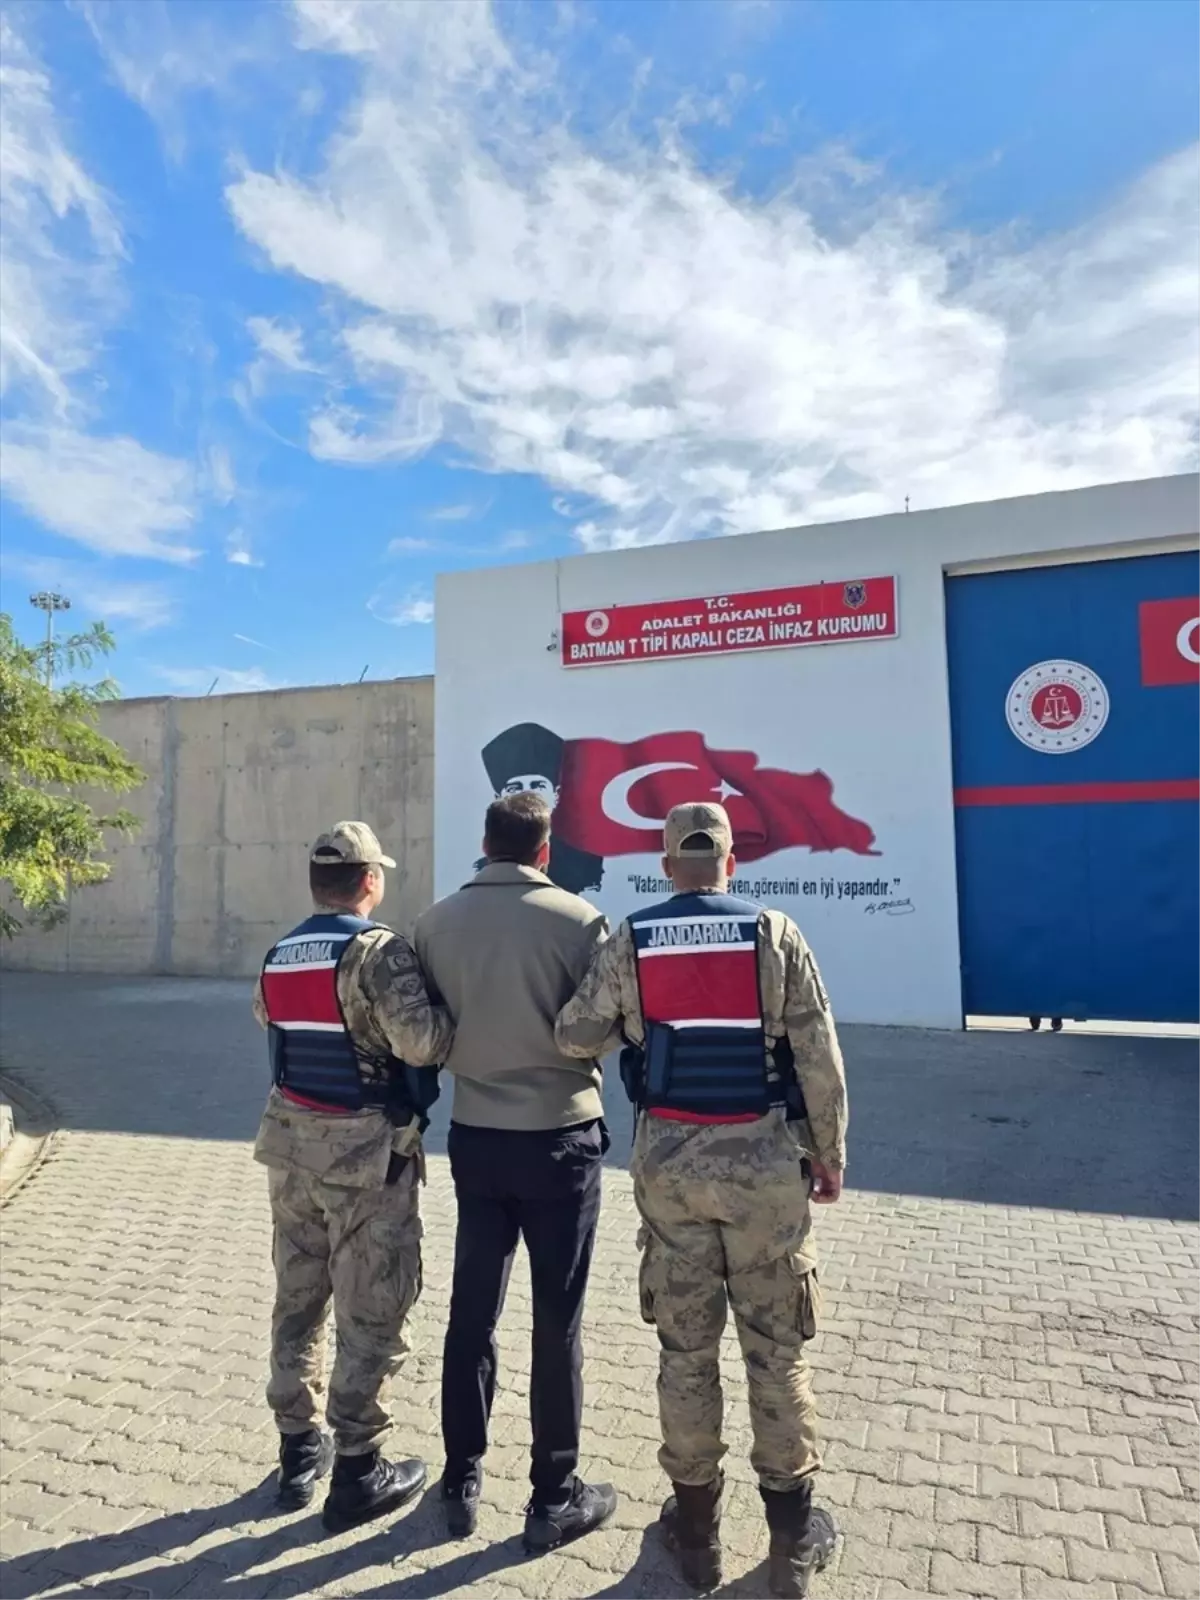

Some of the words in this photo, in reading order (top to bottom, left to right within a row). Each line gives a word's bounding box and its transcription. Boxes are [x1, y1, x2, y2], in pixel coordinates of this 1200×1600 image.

[704, 597, 734, 609] T.C.
[641, 614, 703, 631] ADALET
[708, 603, 802, 624] BAKANLIĞI
[570, 640, 625, 659] BATMAN
[628, 638, 638, 654] T
[640, 632, 668, 653] TİPİ
[671, 630, 722, 650] KAPALI
[726, 625, 765, 645] CEZA
[769, 620, 813, 641] İNFAZ
[817, 613, 887, 636] KURUMU
[803, 880, 817, 895] en
[820, 877, 834, 899] iyi
[648, 922, 742, 946] JANDARMA
[271, 942, 335, 964] JANDARMA
